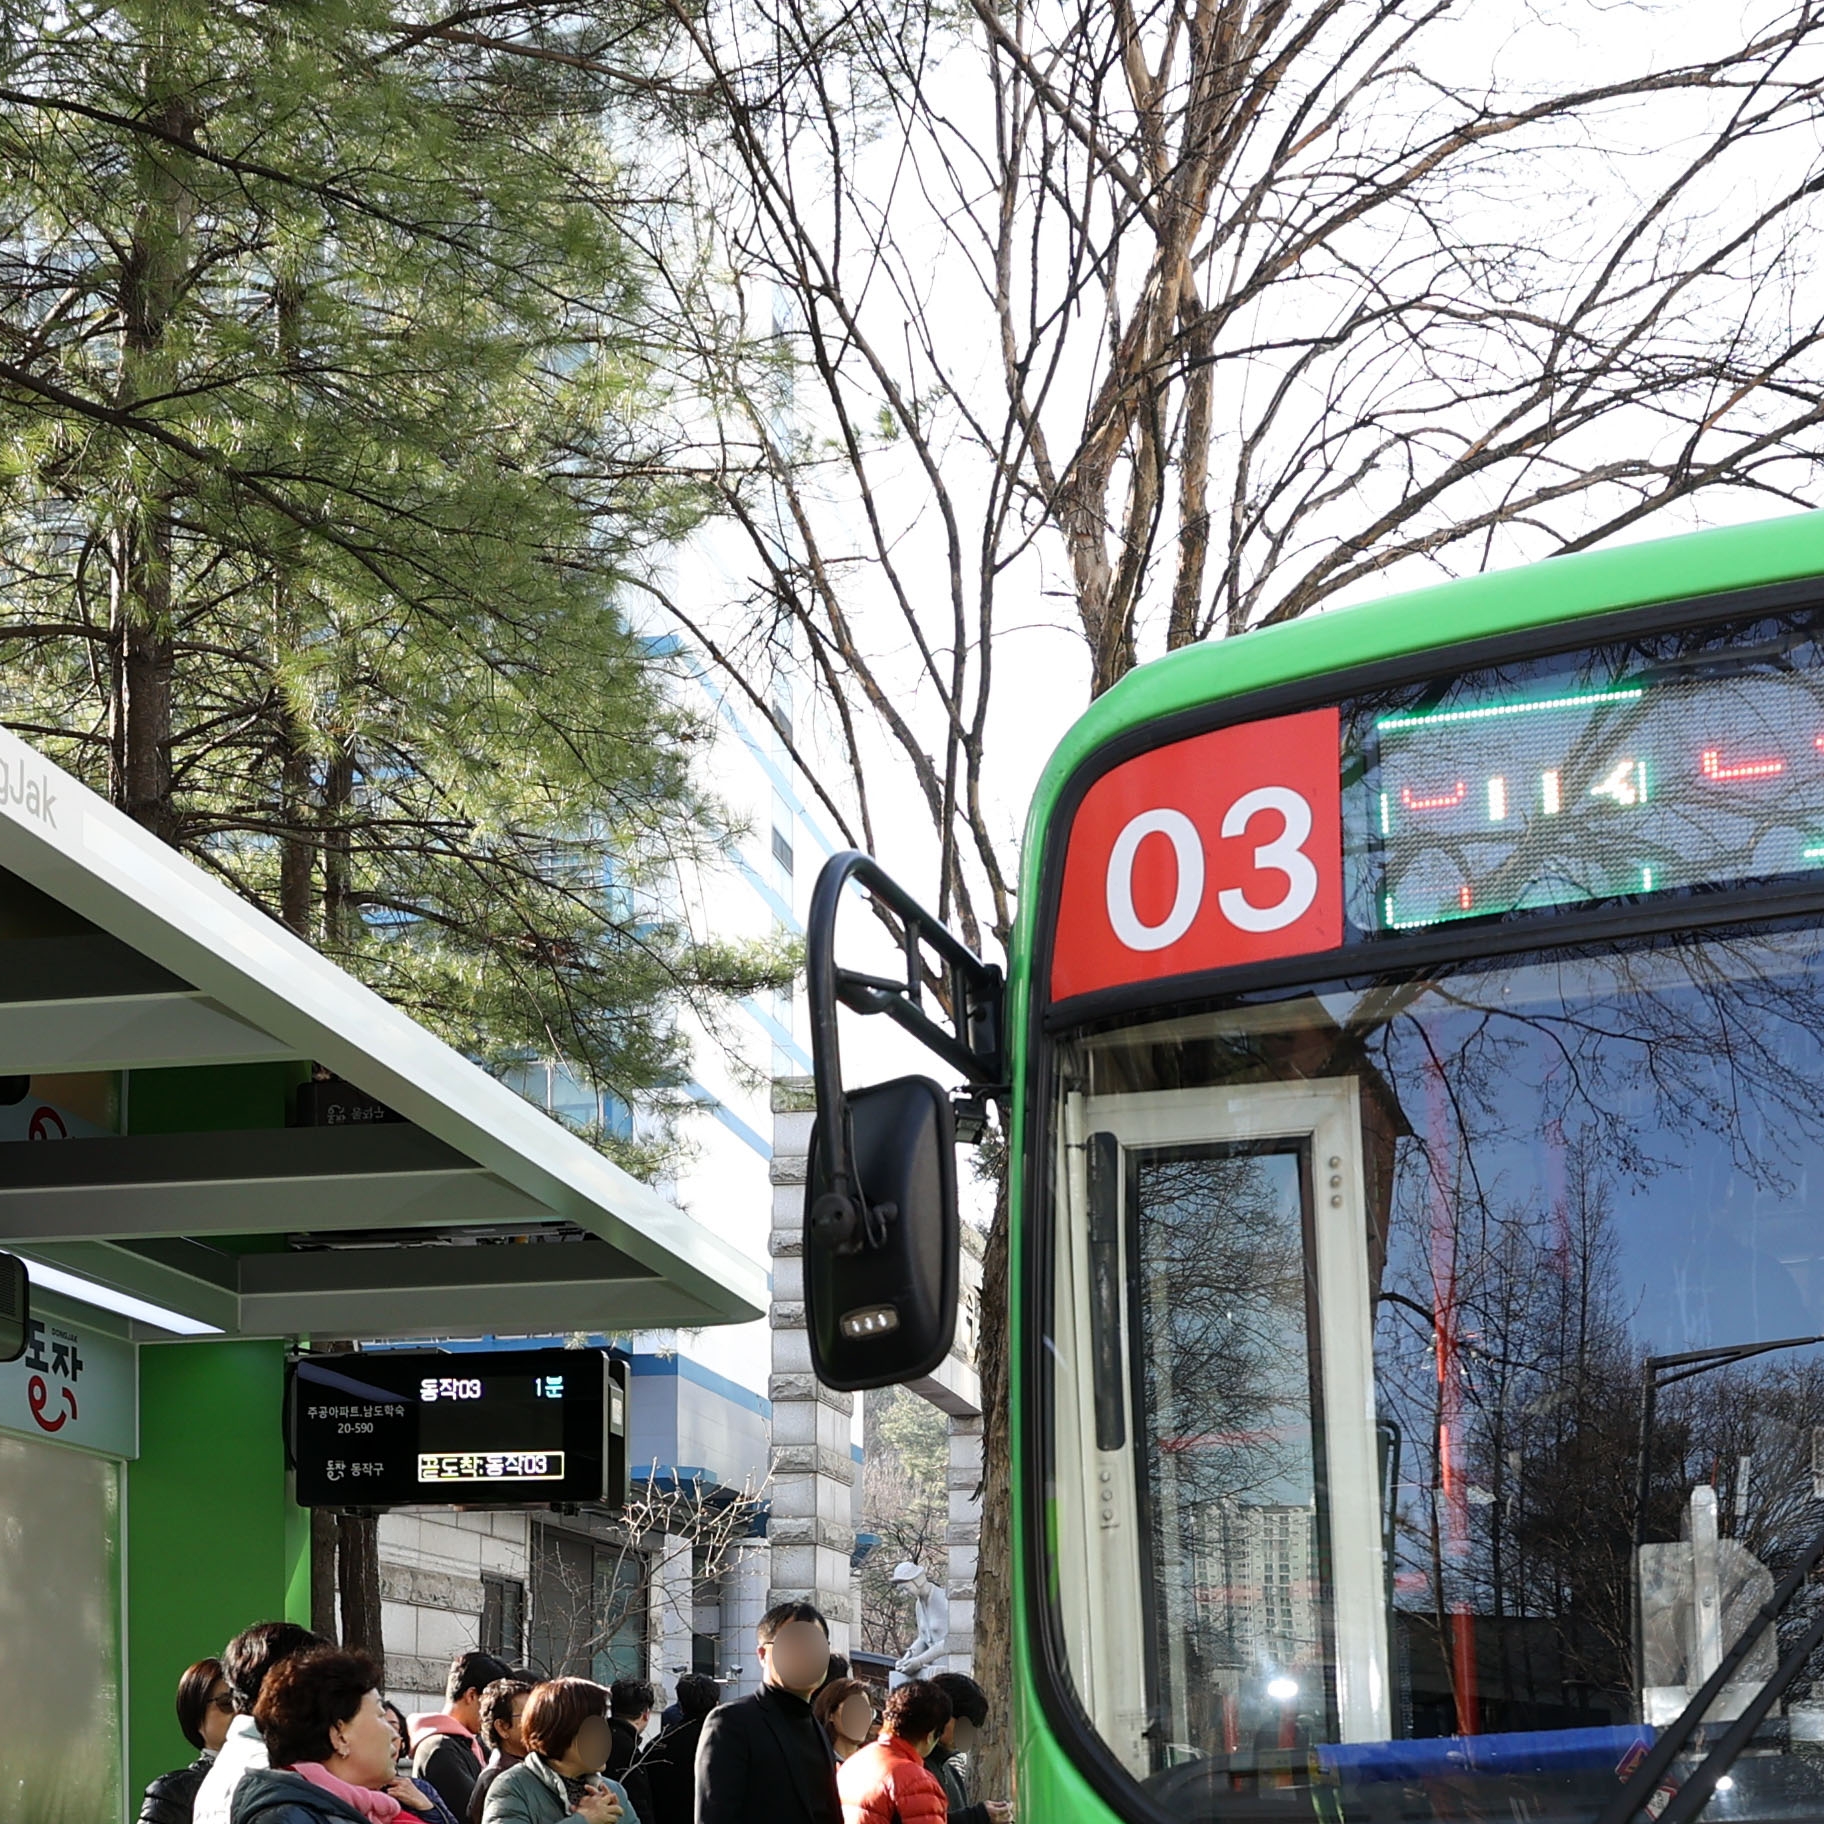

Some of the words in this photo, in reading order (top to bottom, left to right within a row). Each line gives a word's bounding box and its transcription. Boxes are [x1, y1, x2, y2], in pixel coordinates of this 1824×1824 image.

[1105, 785, 1319, 953] 03
[420, 1378, 481, 1401] 동작03
[307, 1404, 405, 1419] 주공아파트.남도학숙
[337, 1422, 374, 1434] 20-590
[350, 1462, 384, 1477] 동작구
